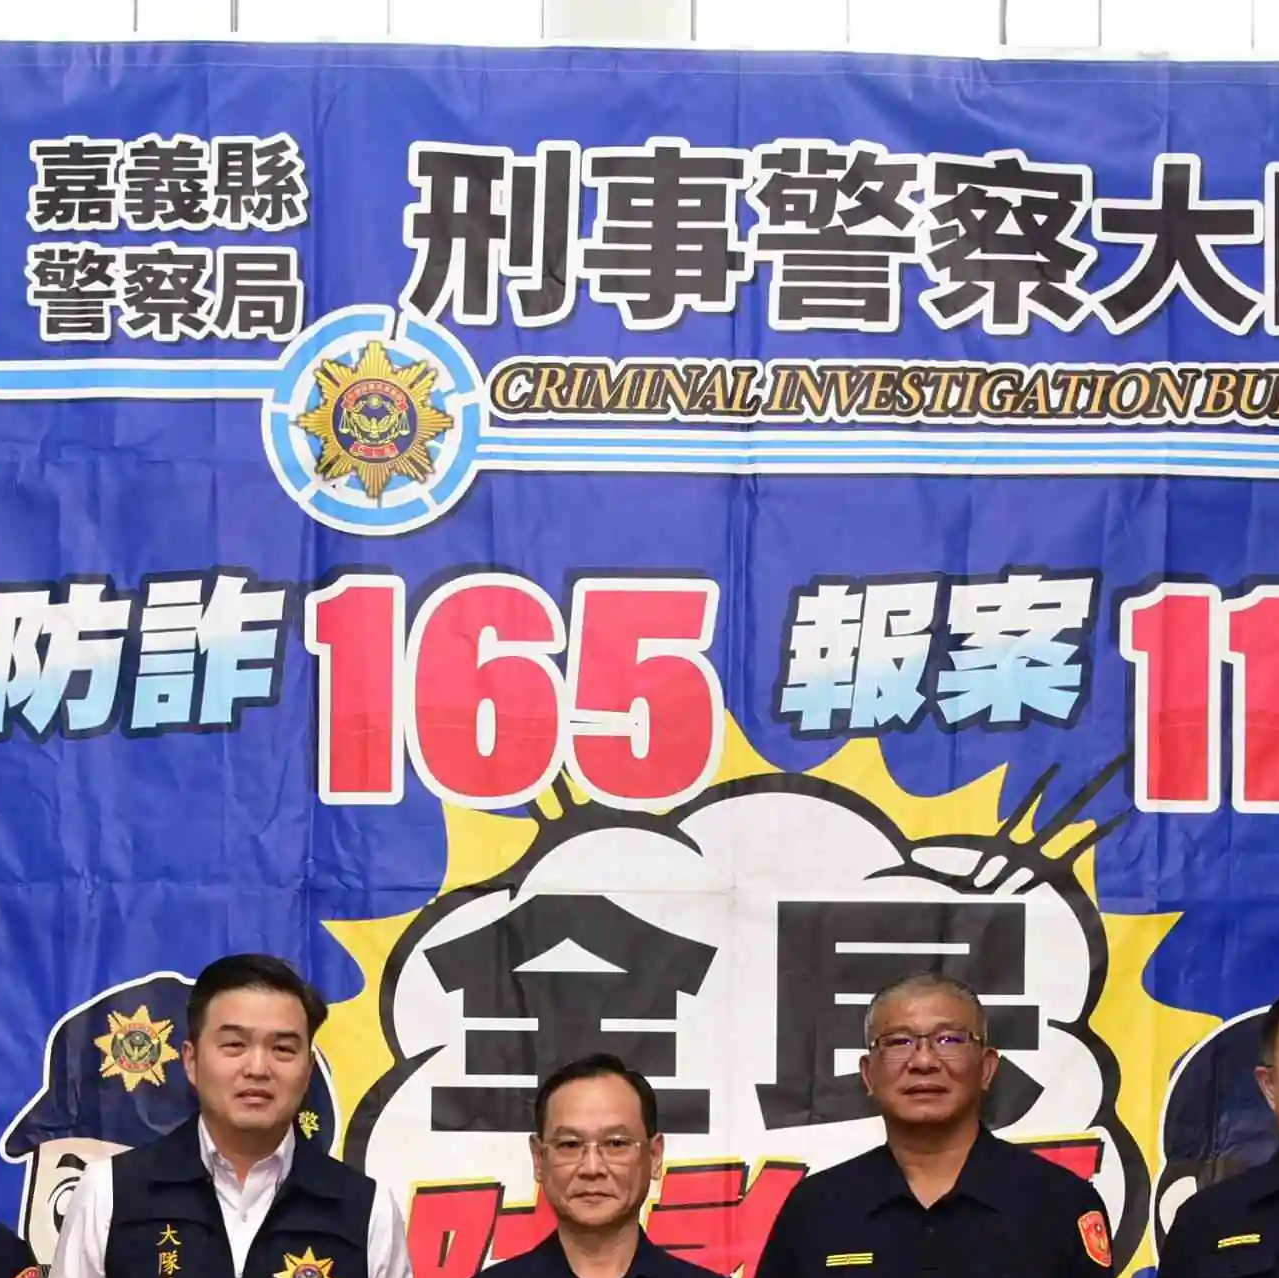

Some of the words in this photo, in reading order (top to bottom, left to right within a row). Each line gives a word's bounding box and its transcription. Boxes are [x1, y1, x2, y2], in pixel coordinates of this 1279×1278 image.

[30, 138, 307, 230] 嘉義縣
[29, 244, 303, 342] 警察局
[491, 357, 760, 420] CRIMINAL
[763, 361, 1201, 426] INVESTIGATION
[305, 573, 722, 811] 165
[781, 569, 1093, 731] 報案
[424, 894, 1045, 1135] 全民
